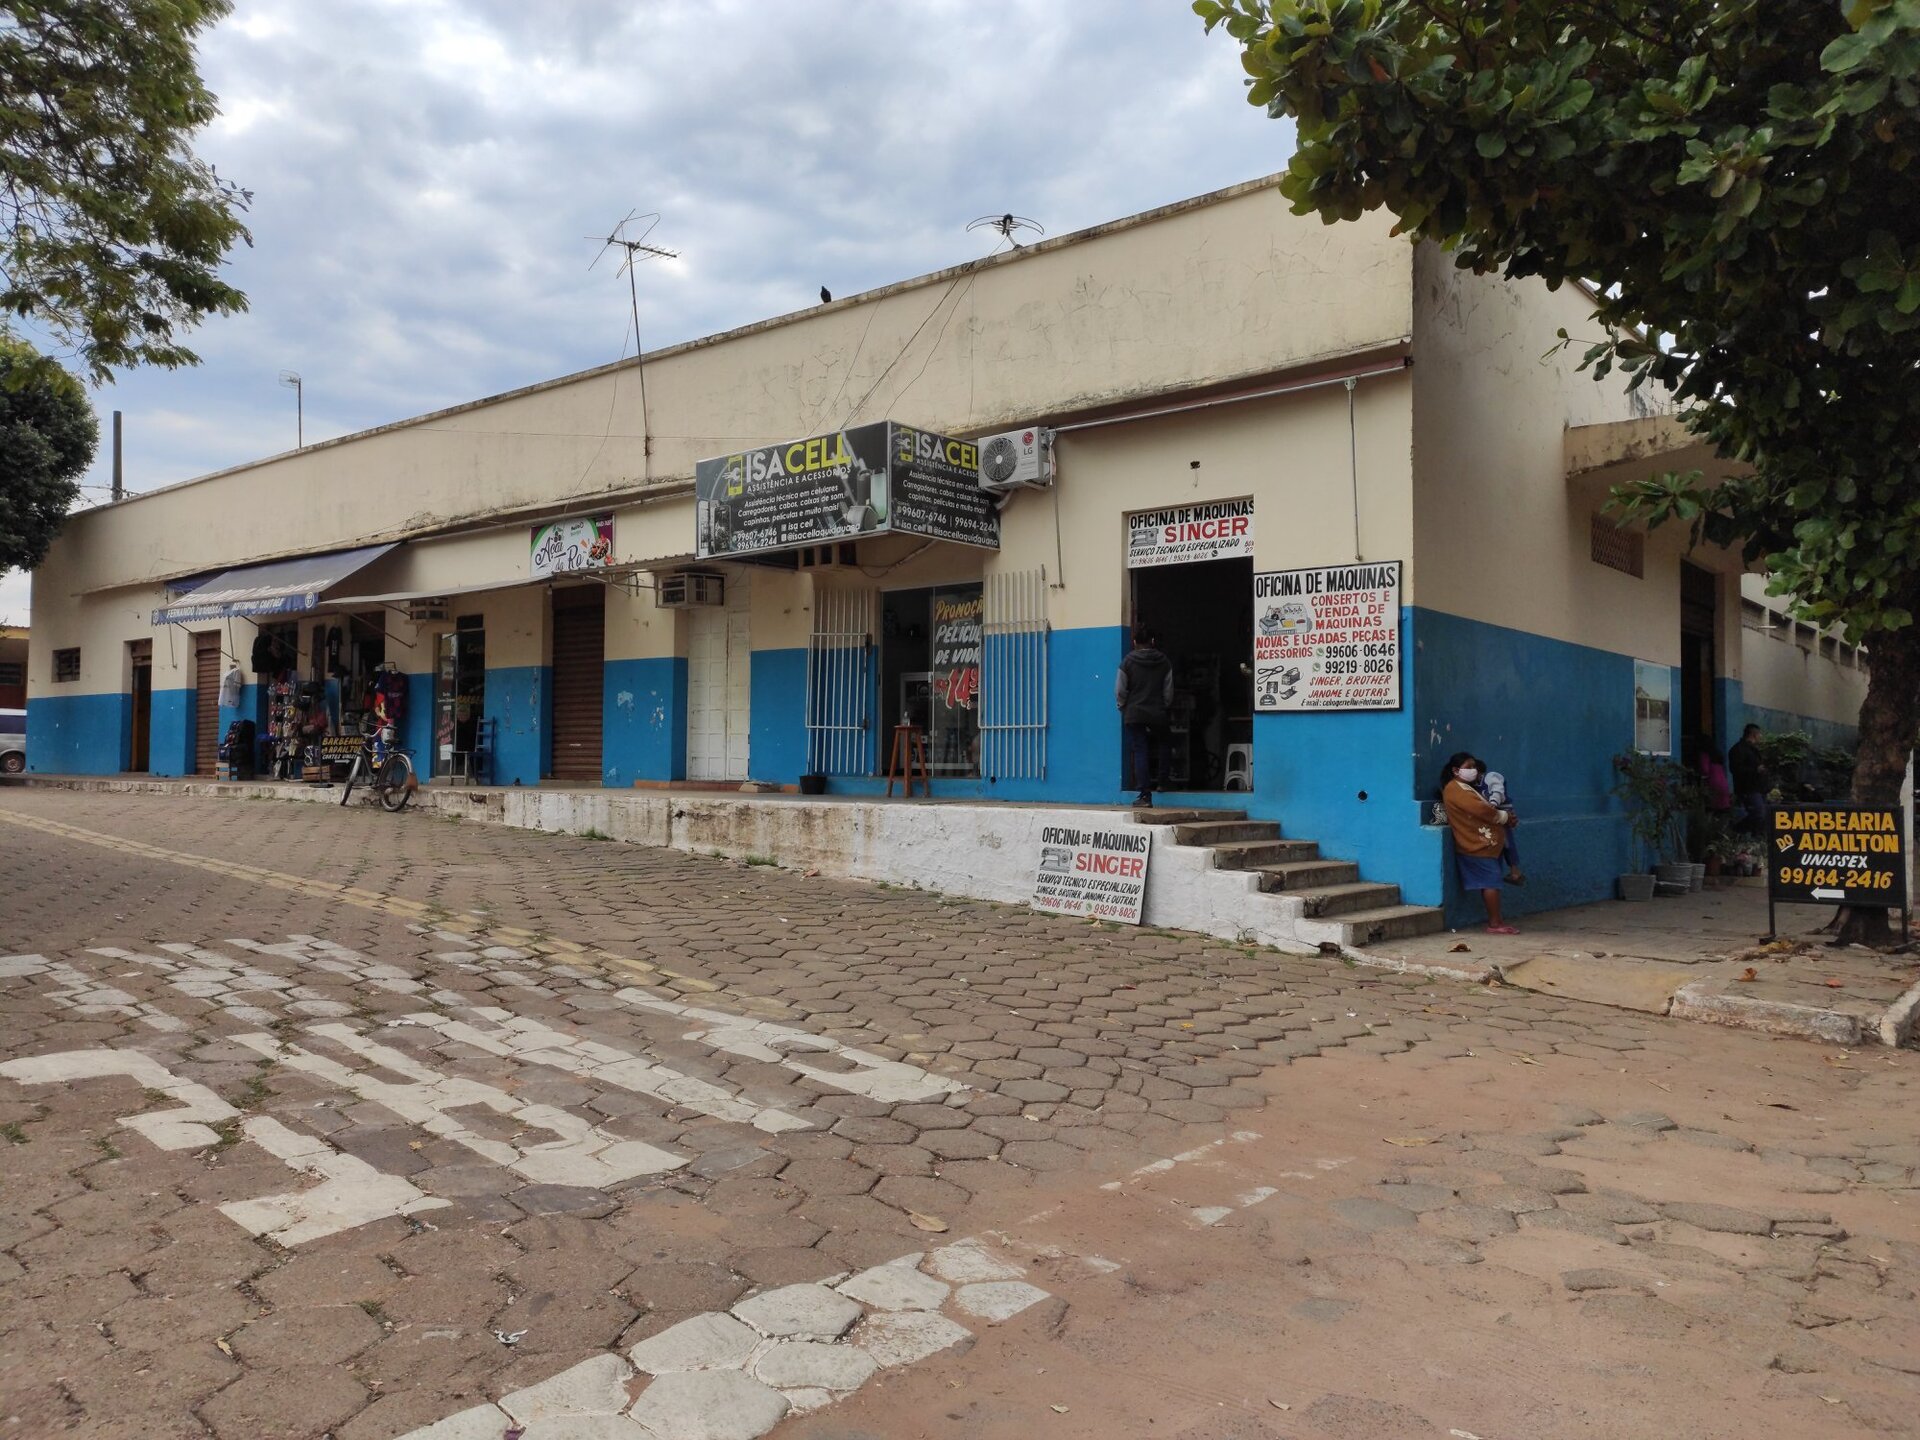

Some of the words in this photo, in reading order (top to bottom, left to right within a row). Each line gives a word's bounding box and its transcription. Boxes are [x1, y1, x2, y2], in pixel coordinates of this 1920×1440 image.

[916, 432, 978, 470] ISACEL
[796, 475, 800, 483] E
[811, 485, 838, 496] celulares
[957, 492, 972, 501] caixas
[800, 498, 820, 507] caixas
[821, 495, 829, 503] de
[902, 506, 947, 524] 99607-6746
[1130, 511, 1175, 529] OFICINA
[1179, 509, 1190, 523] DE
[788, 522, 798, 532] isa
[800, 519, 813, 530] cell
[901, 519, 911, 528] isa
[1165, 517, 1248, 543] SINGER
[1187, 538, 1240, 551] ESPECIALIZADO
[1256, 574, 1302, 598] OFICINA
[1306, 573, 1322, 594] DE
[1311, 592, 1376, 606] CONSERTOS
[1384, 591, 1390, 602] E
[1315, 606, 1360, 618] VENDA
[1368, 604, 1385, 614] DE
[1256, 636, 1288, 649] NOVAS
[1294, 635, 1299, 646] E
[1353, 630, 1386, 644] PEÇAS
[1389, 629, 1395, 640] E
[935, 649, 950, 664] DE
[952, 647, 980, 663] VIDR
[1325, 643, 1395, 658] 99606-0646
[1325, 659, 1393, 674] 99219-8026
[1346, 675, 1392, 685] BROTHER
[1308, 688, 1343, 698] JANOME
[1346, 688, 1351, 698] E
[1352, 688, 1390, 697] OUTRAS
[1775, 811, 1896, 831] BARBEARIA
[1042, 827, 1081, 846] OFICINA
[1082, 834, 1091, 844] DE
[1776, 834, 1793, 850] DO
[1798, 833, 1899, 853] ADAILTON
[1076, 853, 1144, 878] SINGER
[1801, 853, 1868, 868] UNISSEX
[1037, 873, 1062, 886] SERVIÇO
[1087, 879, 1141, 895] ESPECIALIZADO
[1780, 867, 1894, 889] 99184-2416
[1111, 894, 1138, 906] OUTRAS
[1094, 904, 1137, 918] 99219-8026
